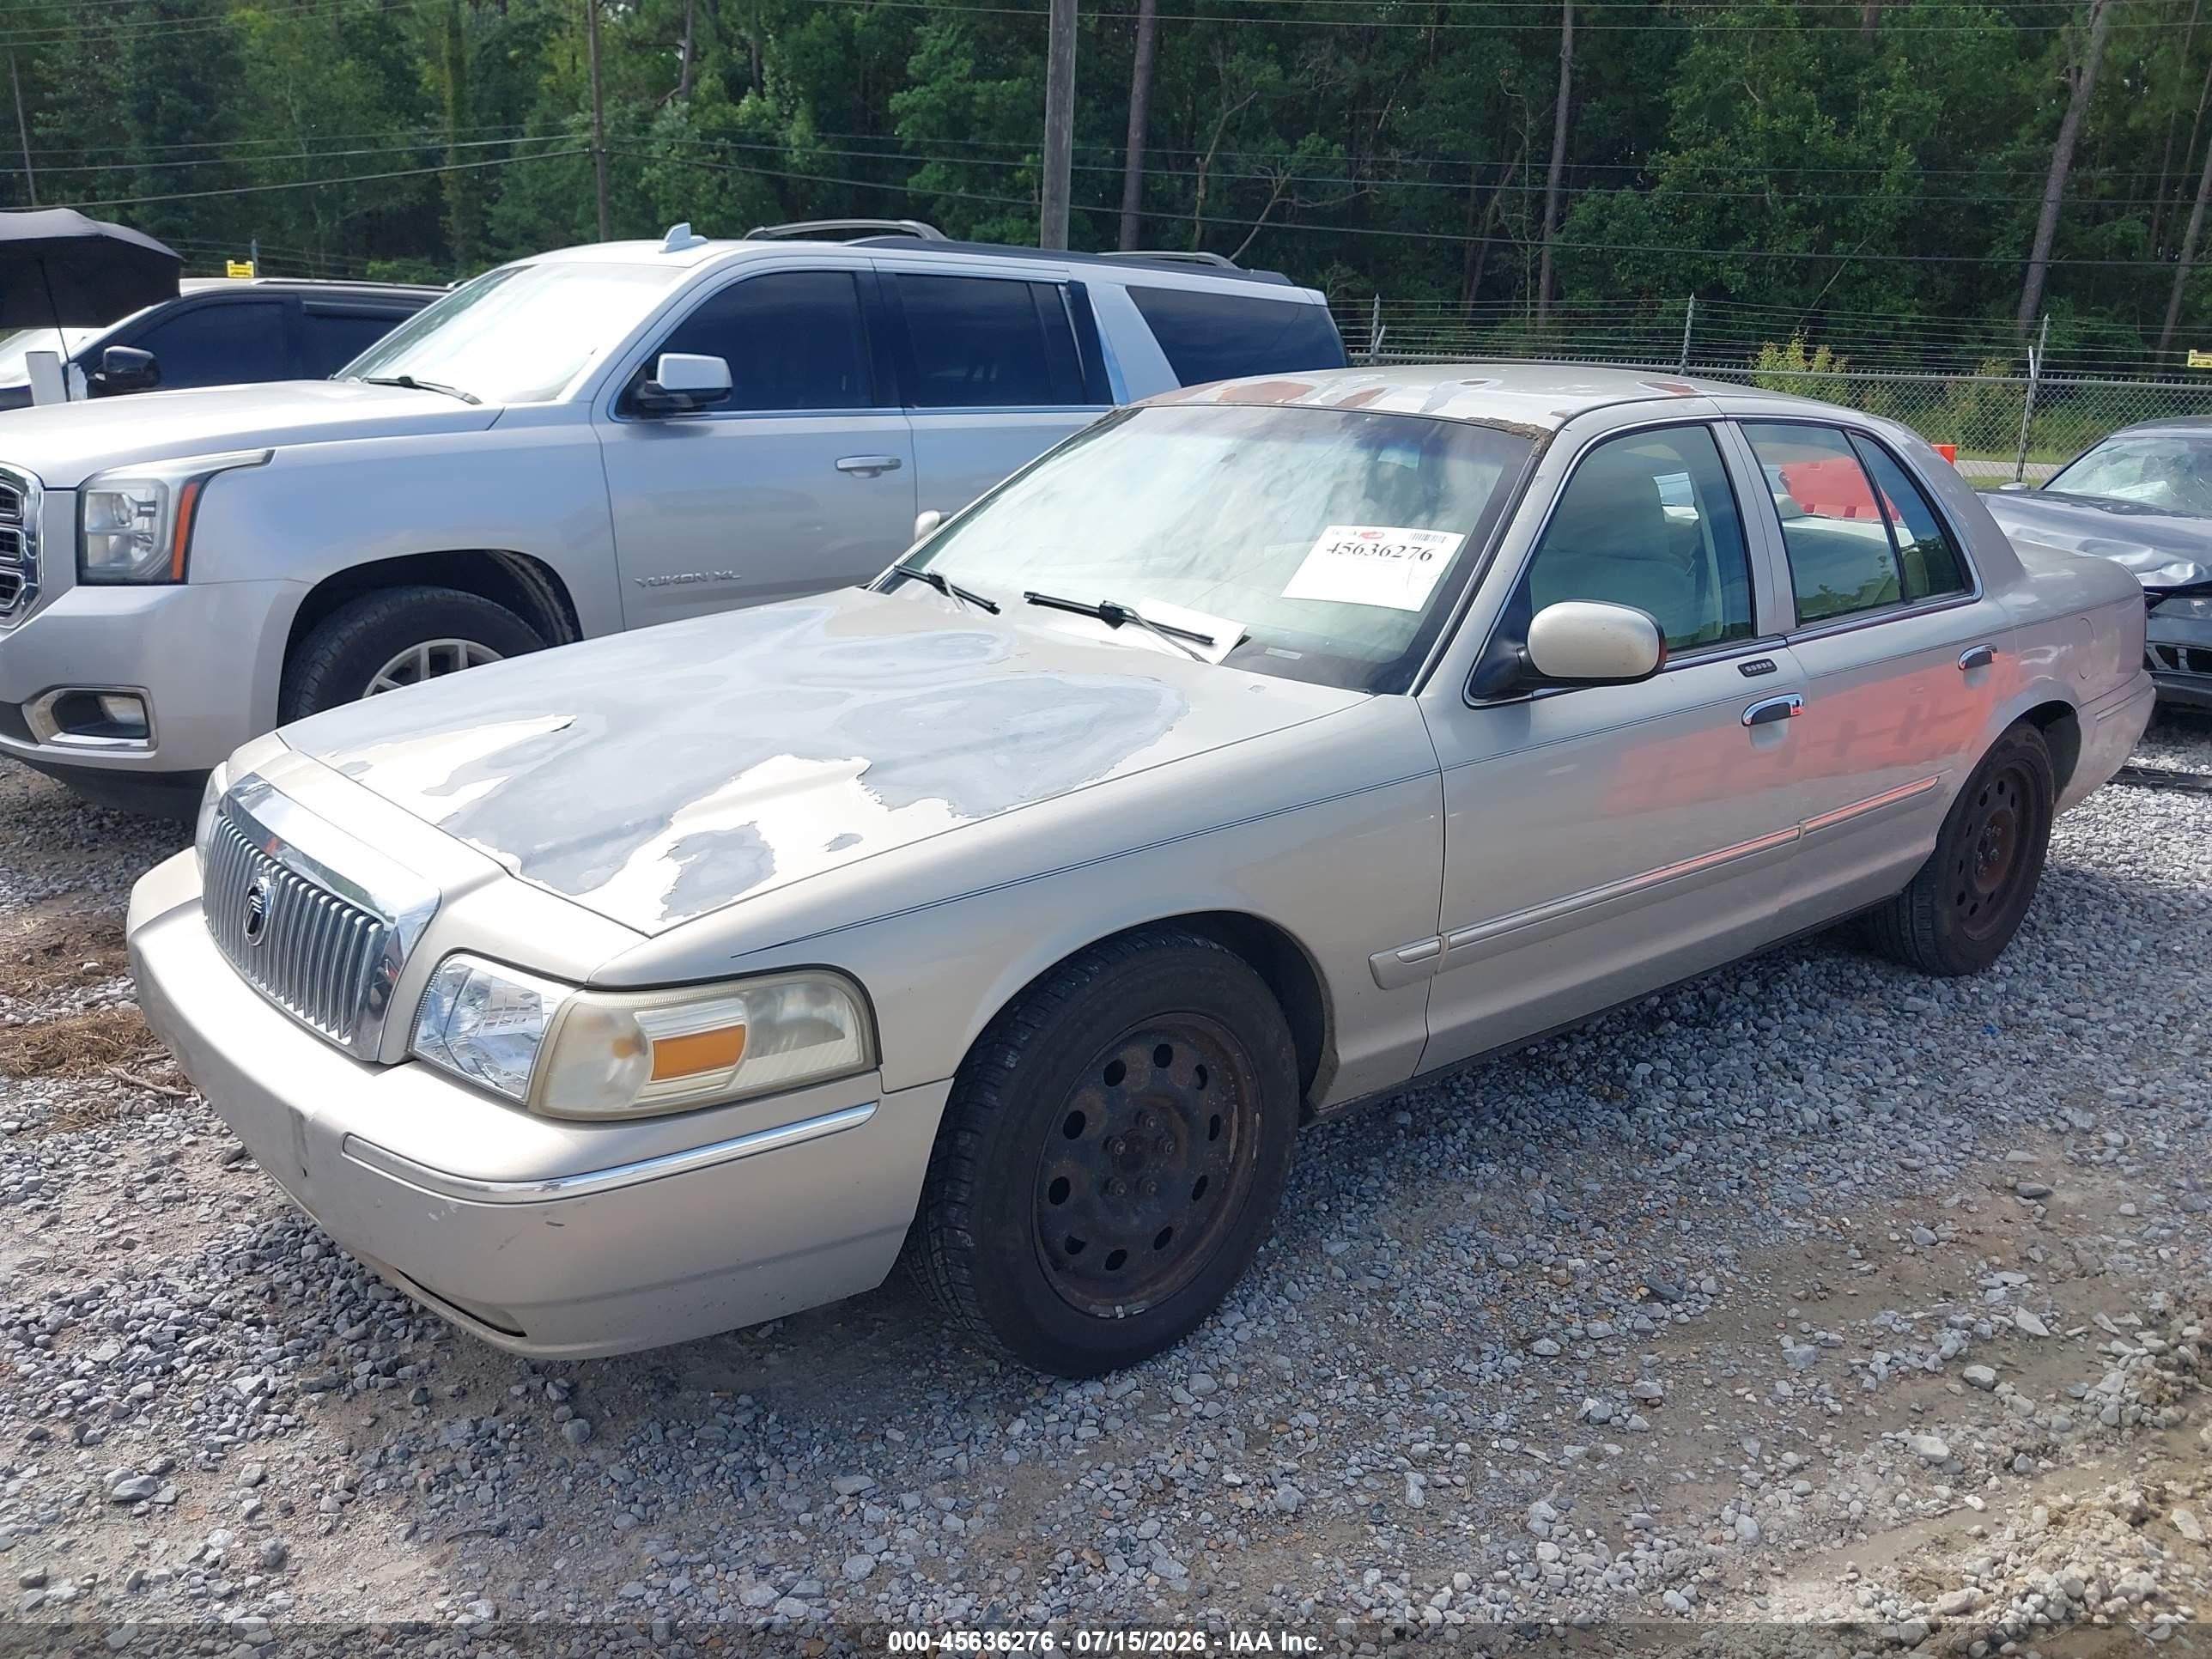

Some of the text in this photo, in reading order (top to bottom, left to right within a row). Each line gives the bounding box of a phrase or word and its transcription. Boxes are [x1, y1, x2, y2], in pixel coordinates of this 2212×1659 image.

[1326, 541, 1437, 562] 45636276
[634, 570, 741, 588] YUKON XL
